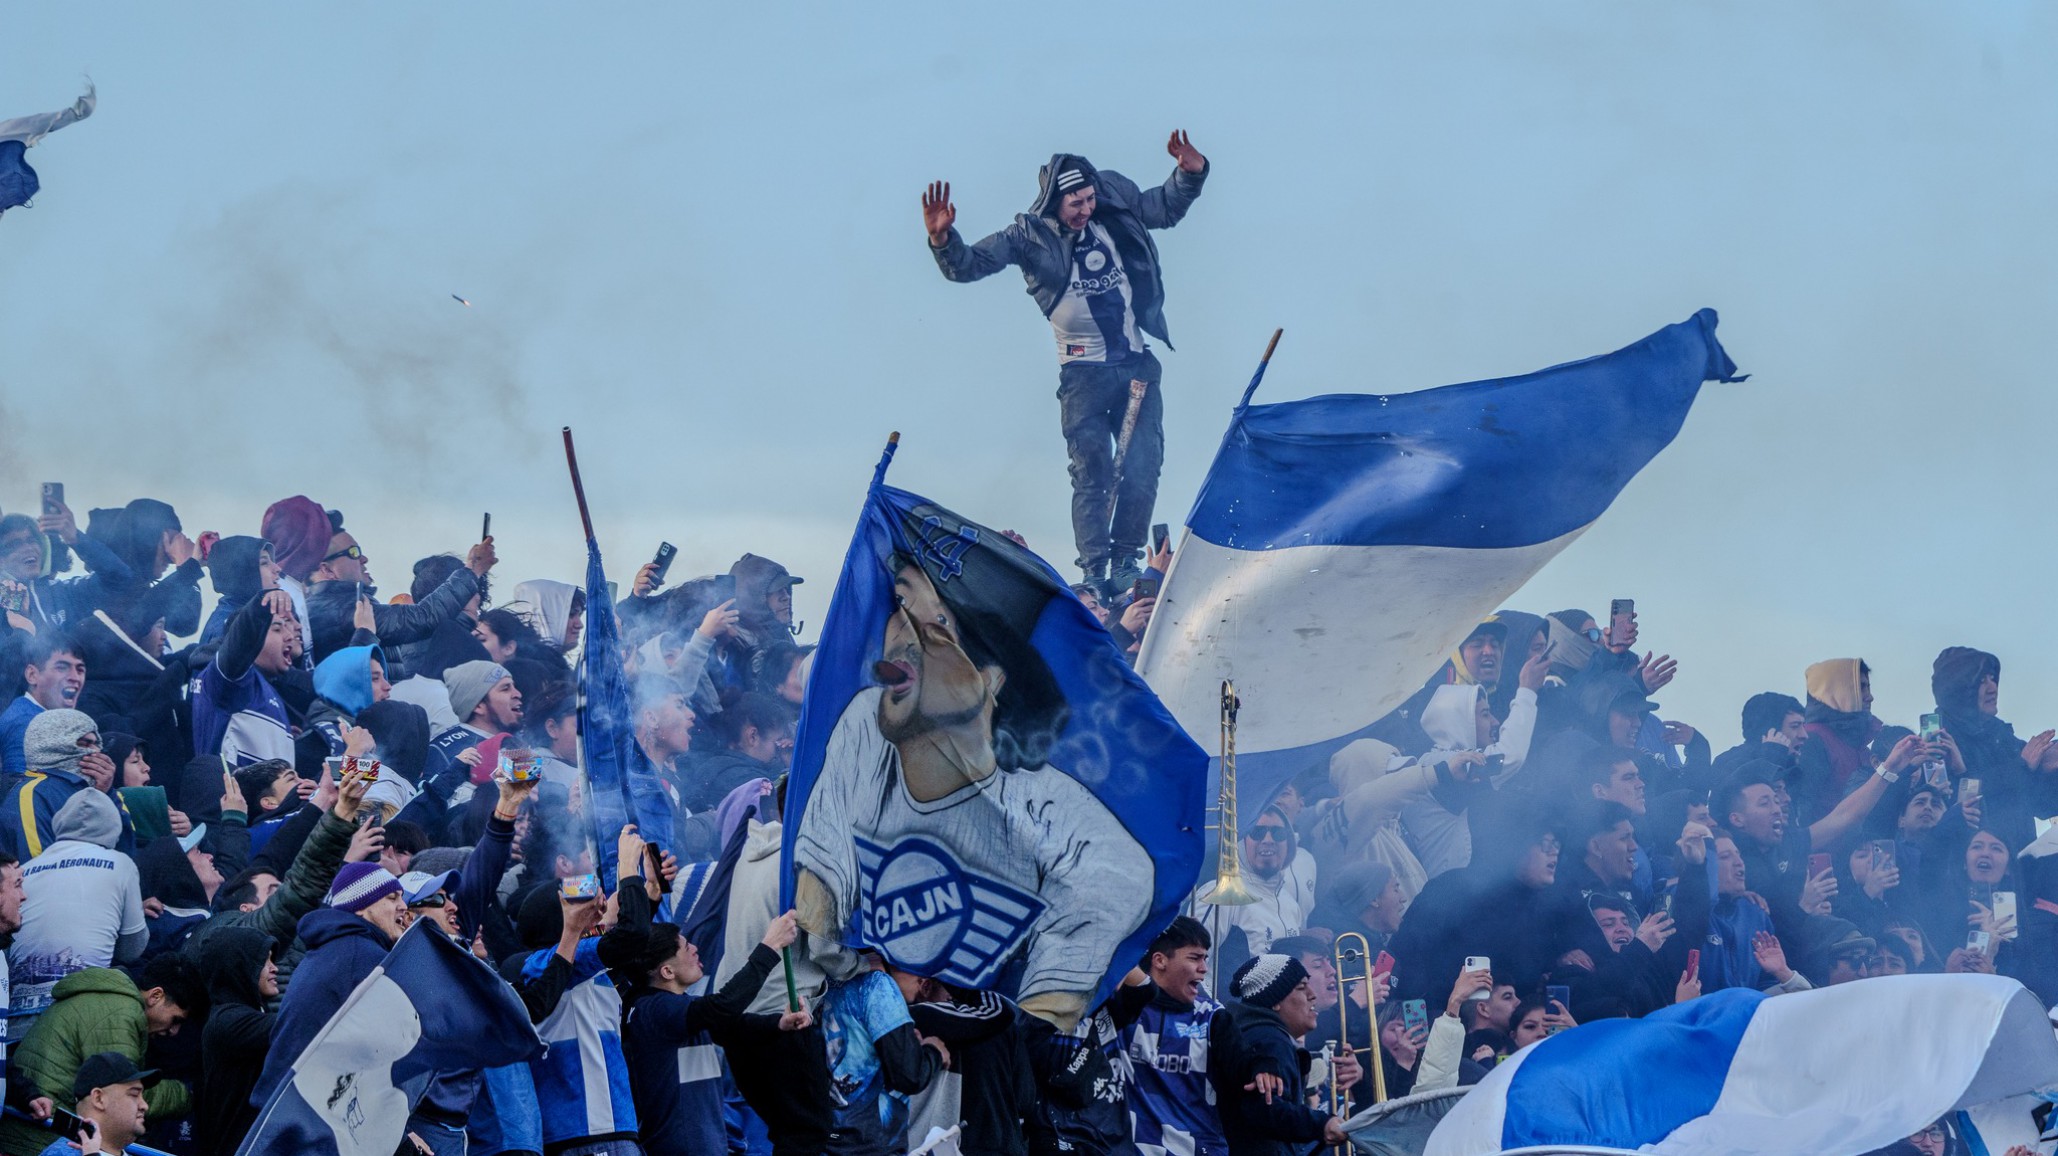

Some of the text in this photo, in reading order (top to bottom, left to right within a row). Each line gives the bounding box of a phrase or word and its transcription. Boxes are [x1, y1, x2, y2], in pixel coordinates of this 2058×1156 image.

[439, 730, 469, 747] LYON
[358, 760, 371, 768] 100
[59, 857, 114, 870] AERONAUTA
[874, 879, 965, 940] CAJN
[1067, 1047, 1090, 1074] Kappa
